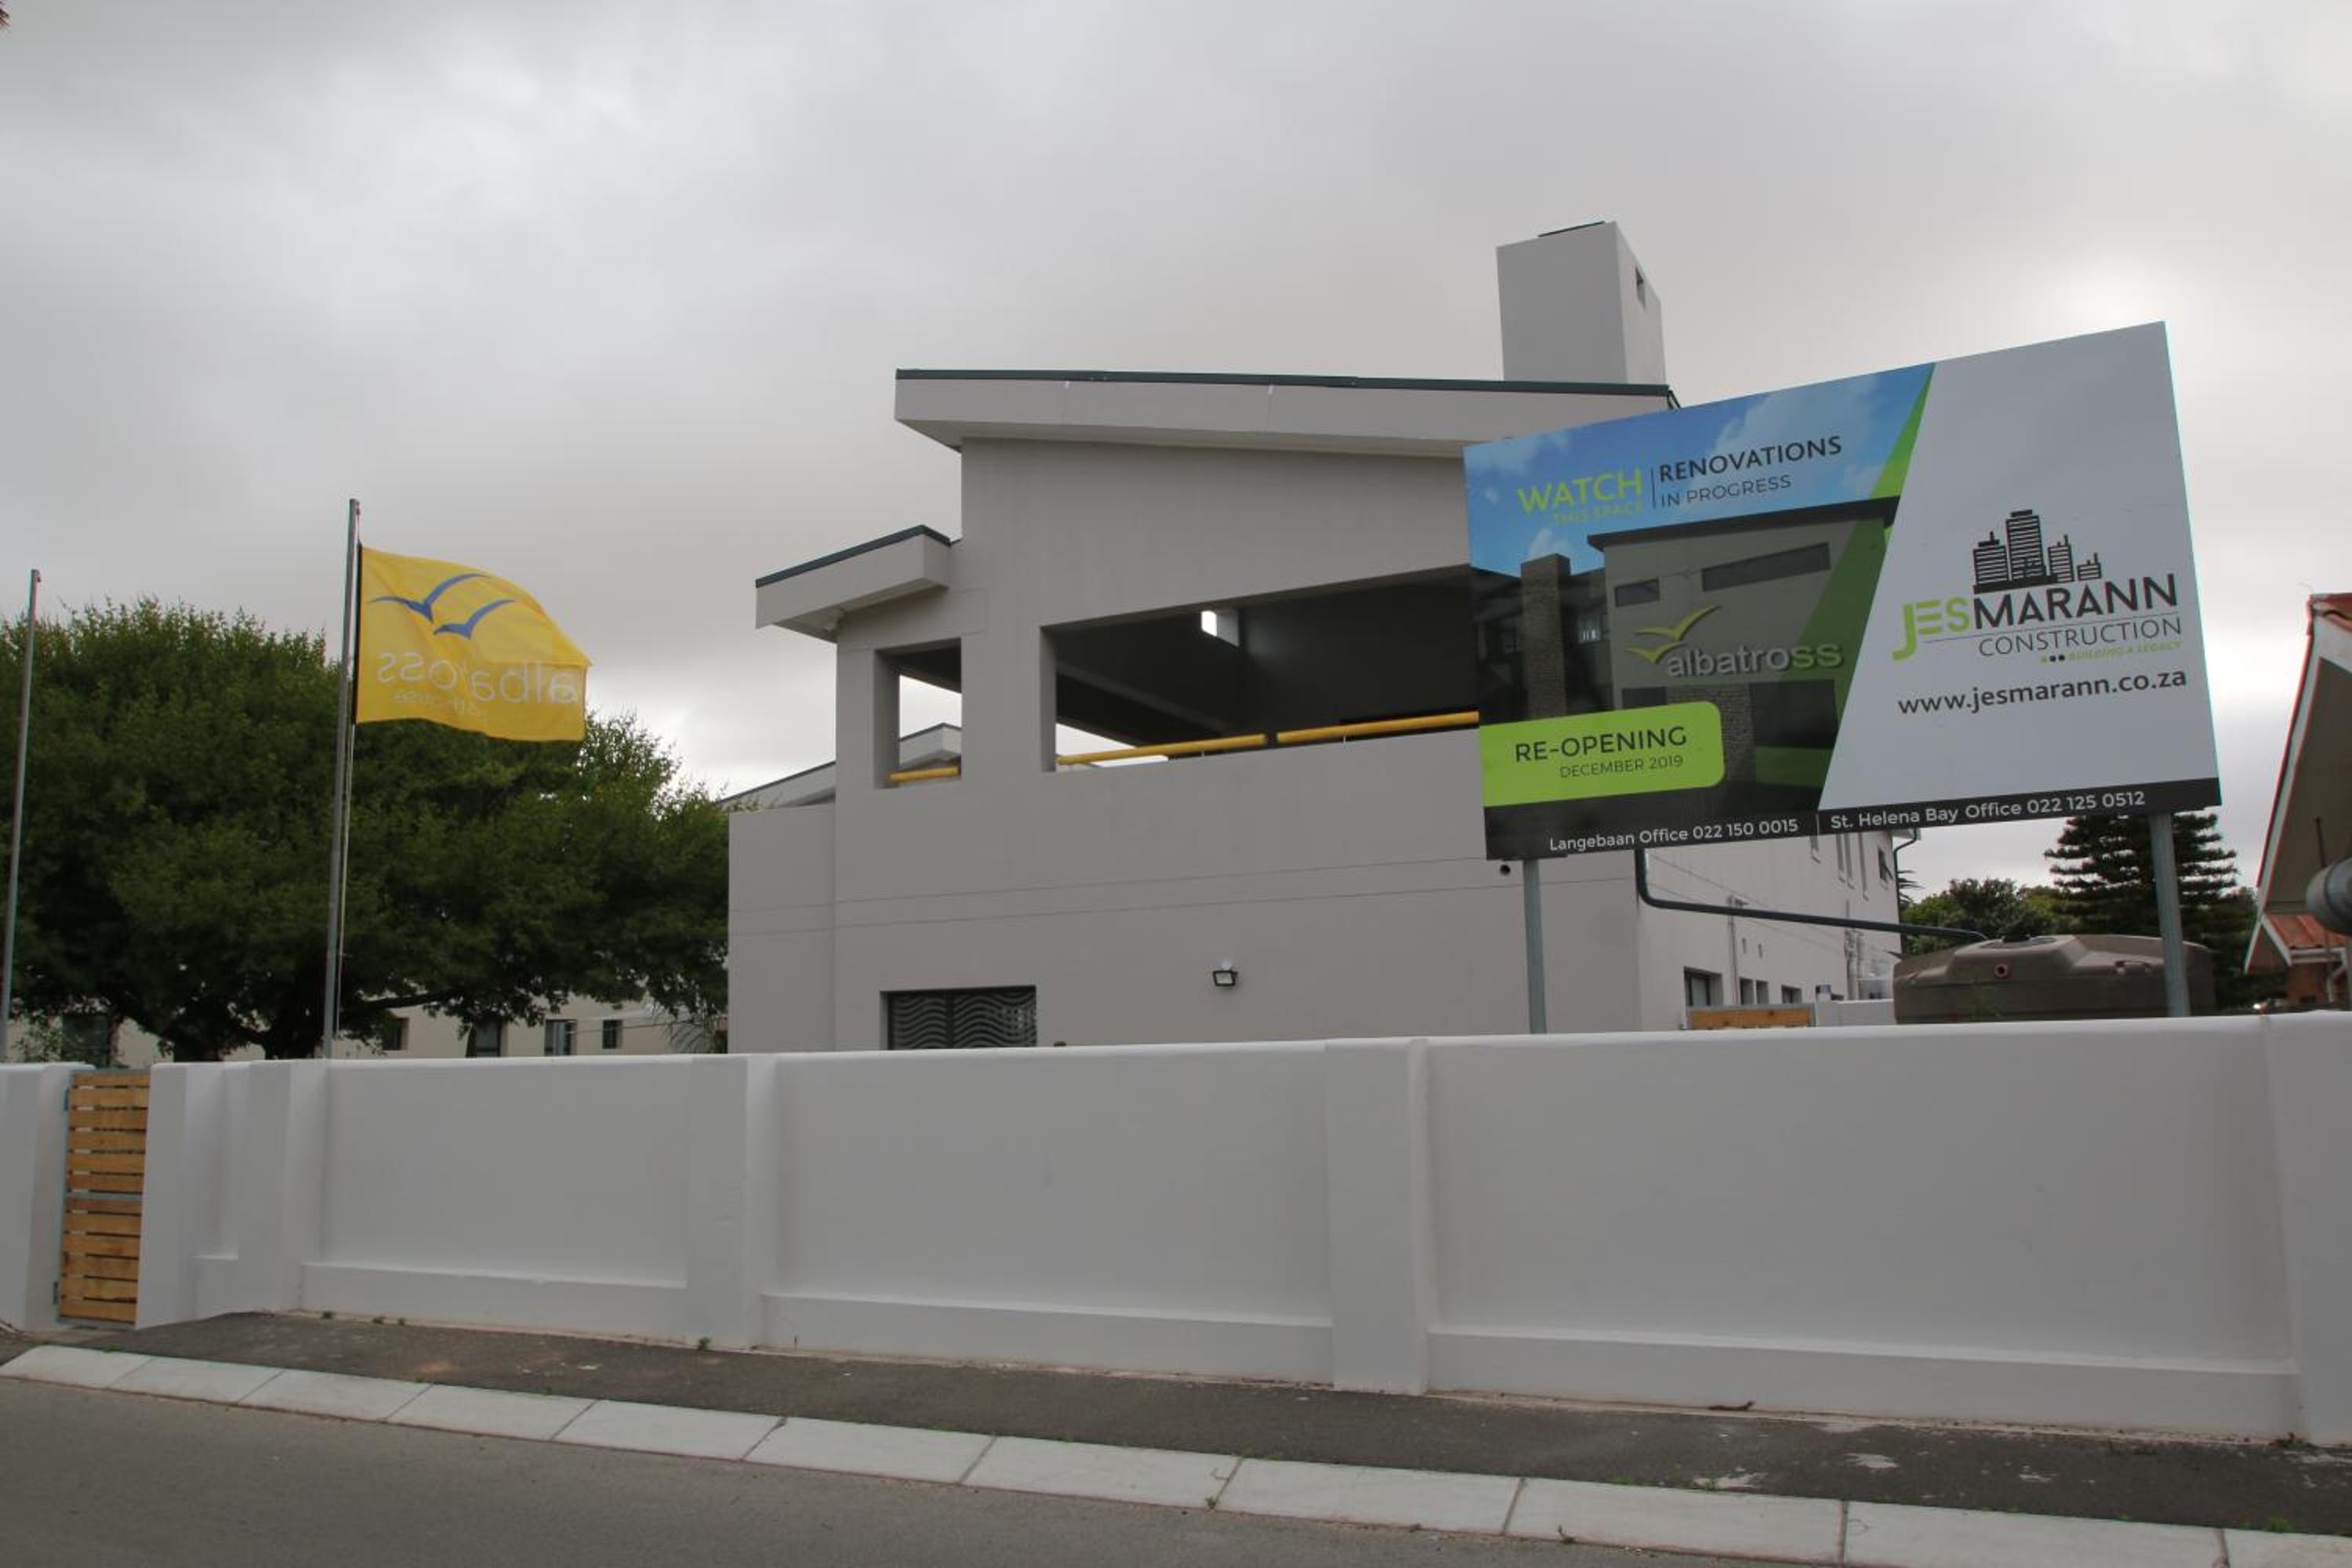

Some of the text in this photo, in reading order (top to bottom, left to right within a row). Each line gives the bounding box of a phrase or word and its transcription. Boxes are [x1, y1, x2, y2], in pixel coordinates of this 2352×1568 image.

[1659, 436, 1842, 482] RENOVATIONS
[1516, 468, 1642, 514] WATCH
[1661, 474, 1792, 508] IN PROGRESS
[1979, 617, 2182, 657] CONSTRUCTION
[1668, 642, 1844, 677] albatross
[1897, 670, 2187, 714] www.jesmarann.co.za
[1515, 726, 1686, 762] RE-OPENING
[1560, 755, 1683, 779] DECEMBER 2019
[1831, 791, 2146, 829] St. Helena Bay Office 022 125 0512
[1550, 818, 1798, 851] Langebaan Office 022 150 0015
